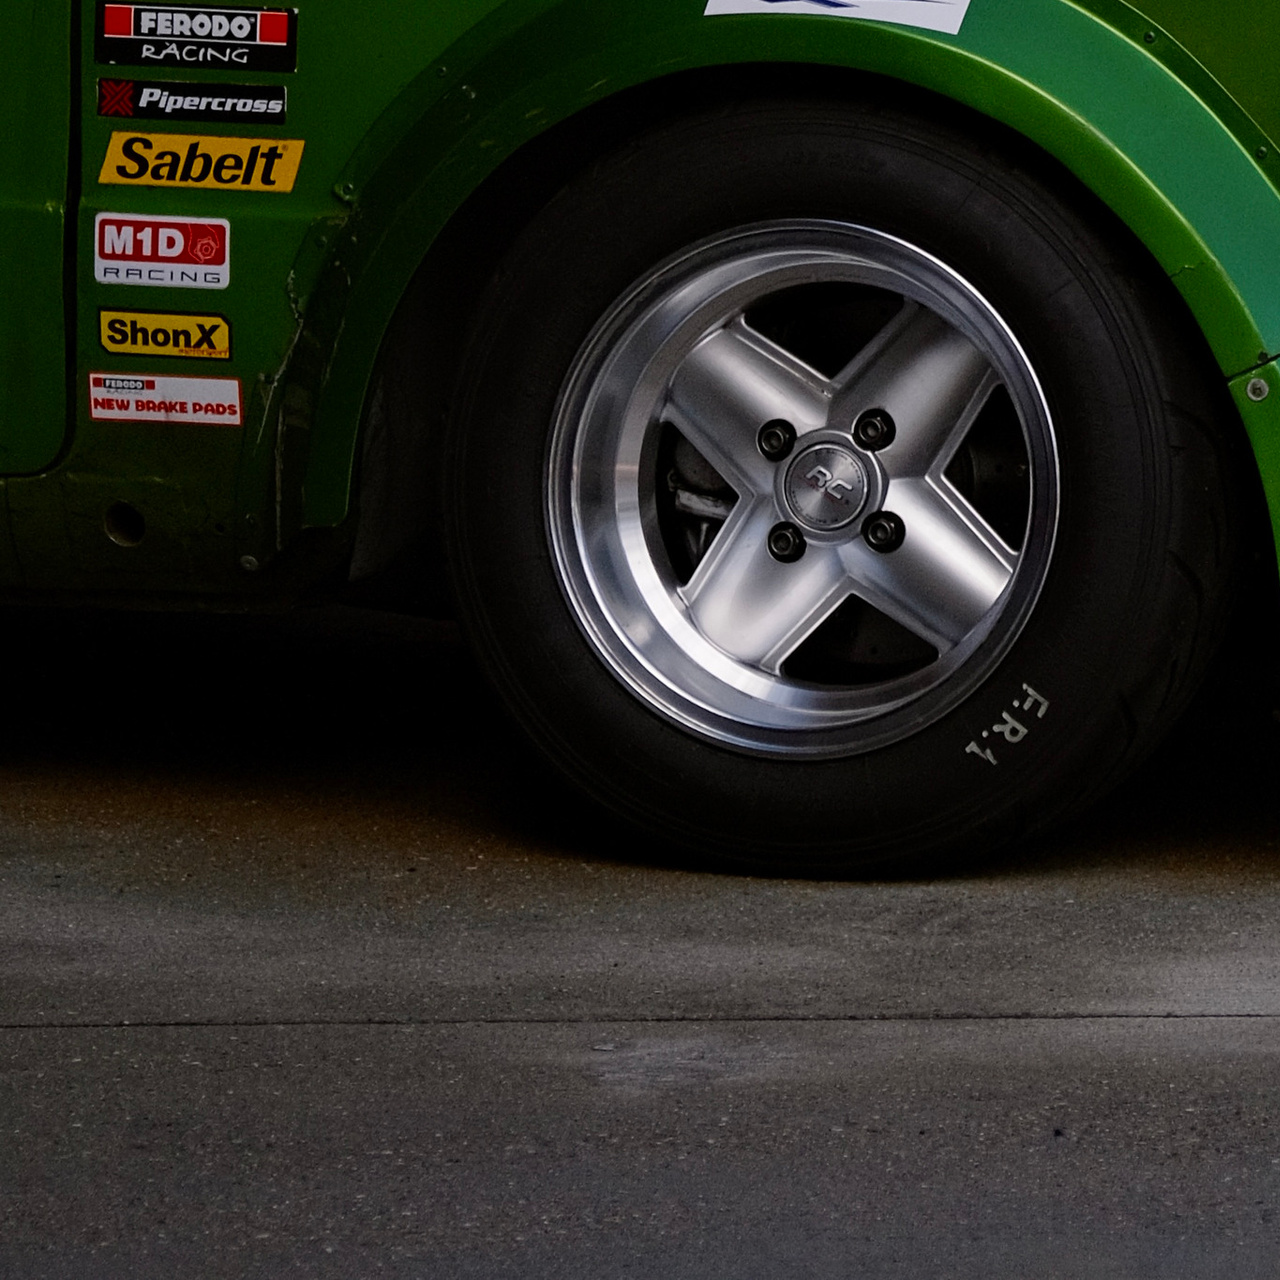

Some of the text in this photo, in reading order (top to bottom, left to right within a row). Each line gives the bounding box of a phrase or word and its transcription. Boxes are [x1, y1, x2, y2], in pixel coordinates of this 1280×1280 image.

[140, 11, 251, 39] FERODO
[141, 41, 250, 64] RACING
[138, 87, 284, 114] Pipercross
[115, 136, 283, 187] Sabelt
[103, 224, 185, 258] M1D
[103, 266, 221, 284] RACING
[106, 318, 221, 350] ShonX
[93, 397, 238, 416] NEW BRAKE PADS
